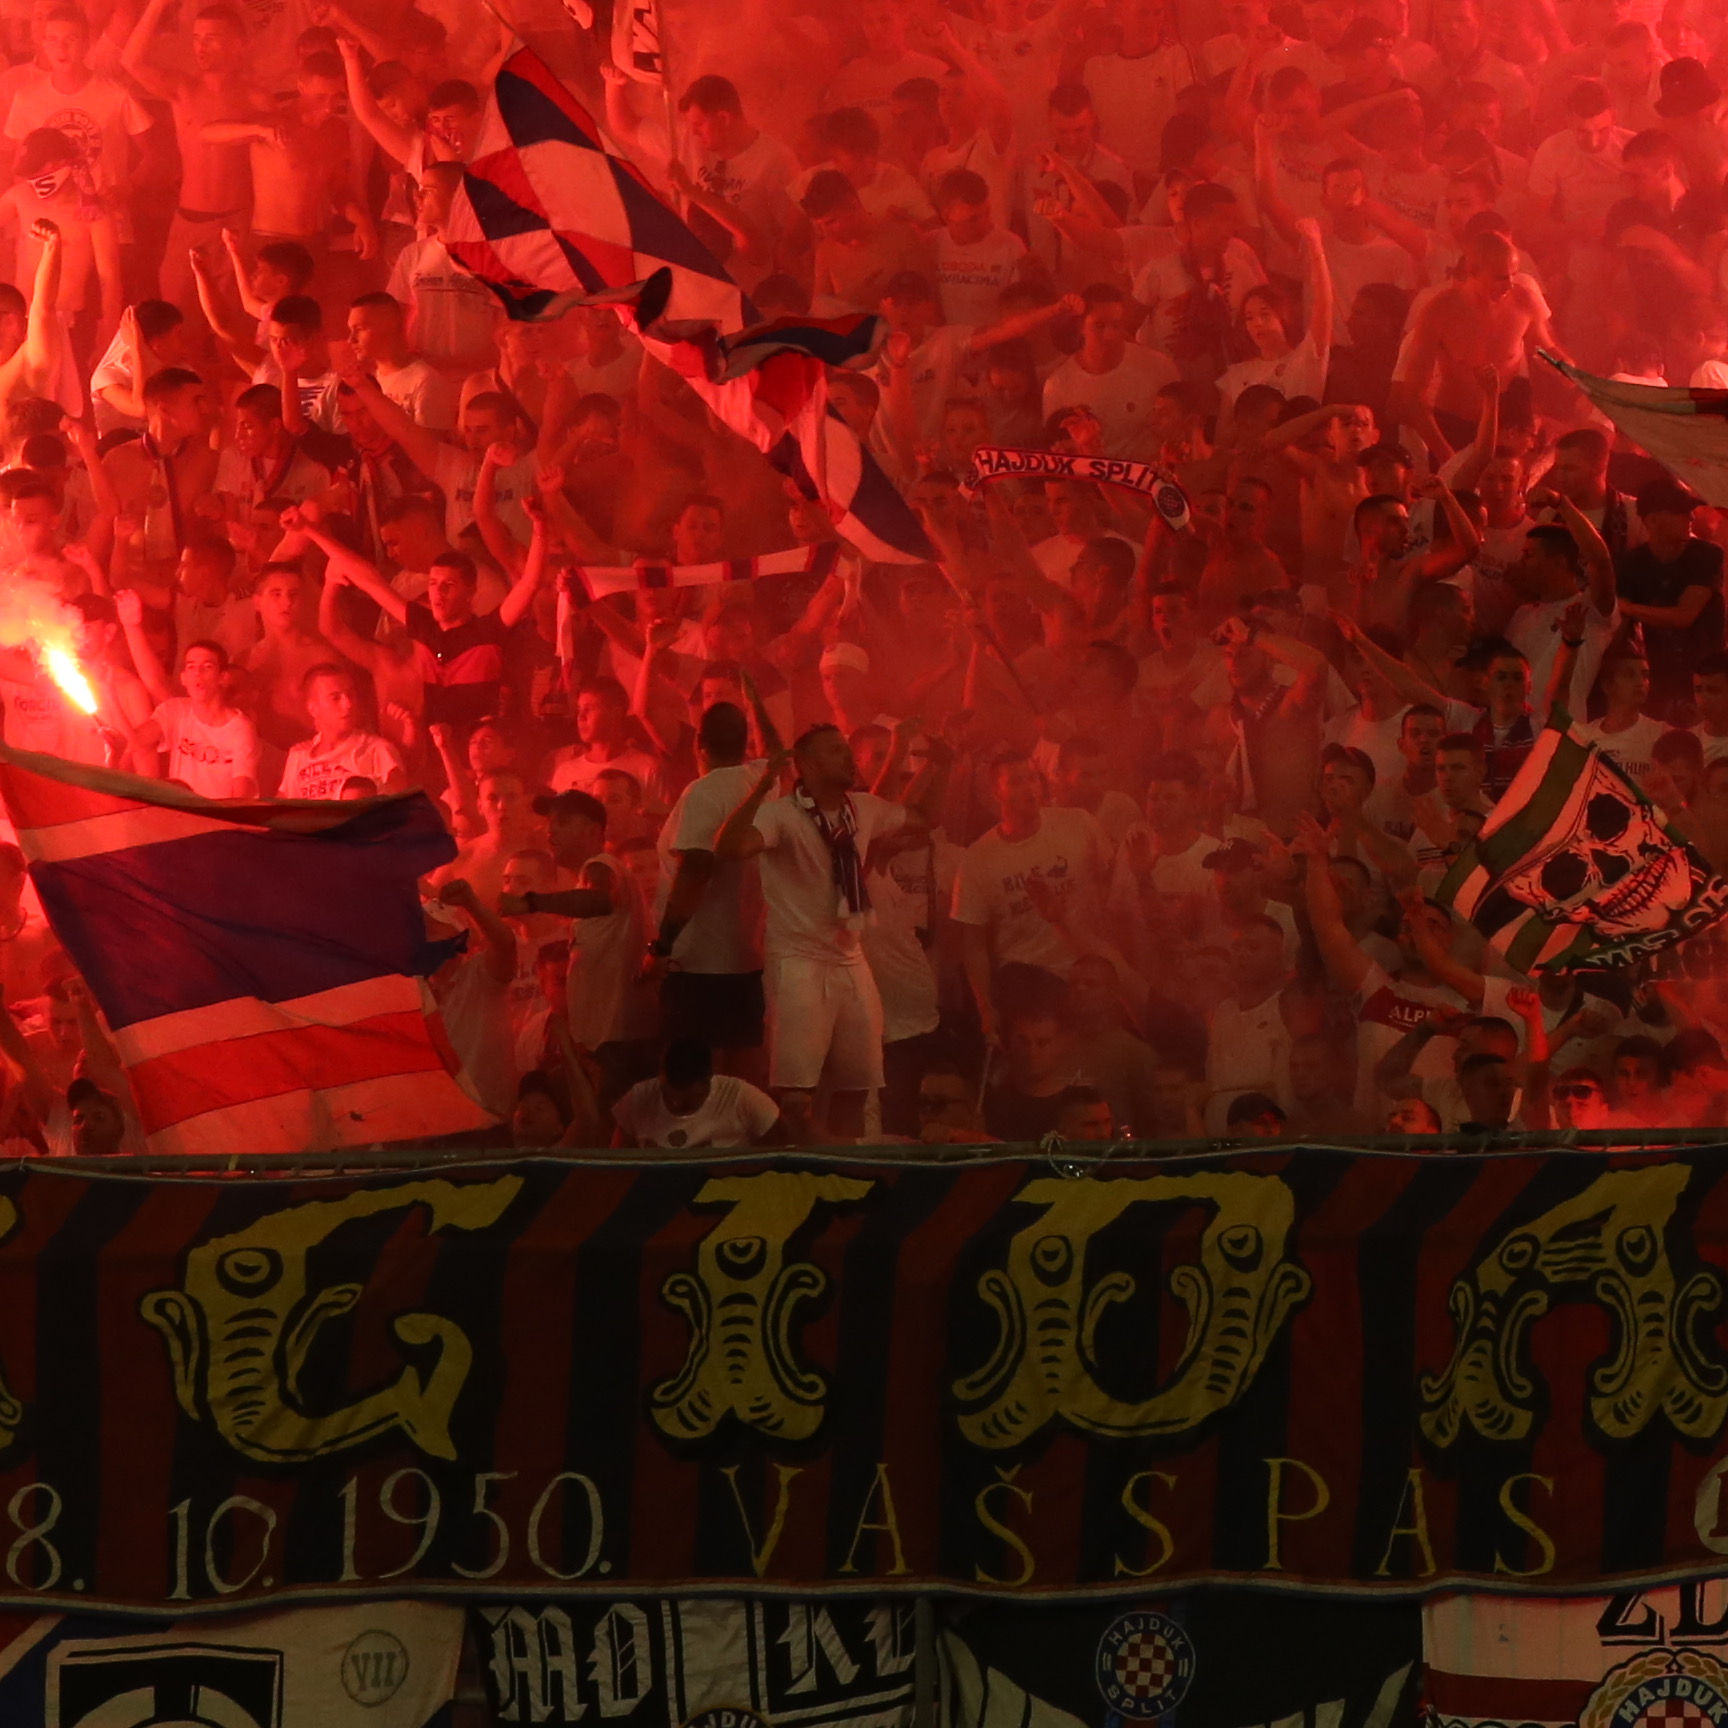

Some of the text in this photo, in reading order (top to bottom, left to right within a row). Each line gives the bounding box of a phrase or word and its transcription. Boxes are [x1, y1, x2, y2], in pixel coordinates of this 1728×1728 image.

[978, 450, 1159, 492] HAJDUK SPLIT
[168, 1495, 275, 1600] 10.
[337, 1467, 612, 1584] 1950.
[1106, 1619, 1185, 1650] HAJDUK
[352, 1651, 398, 1692] VII
[1106, 1684, 1179, 1715] SPLIT
